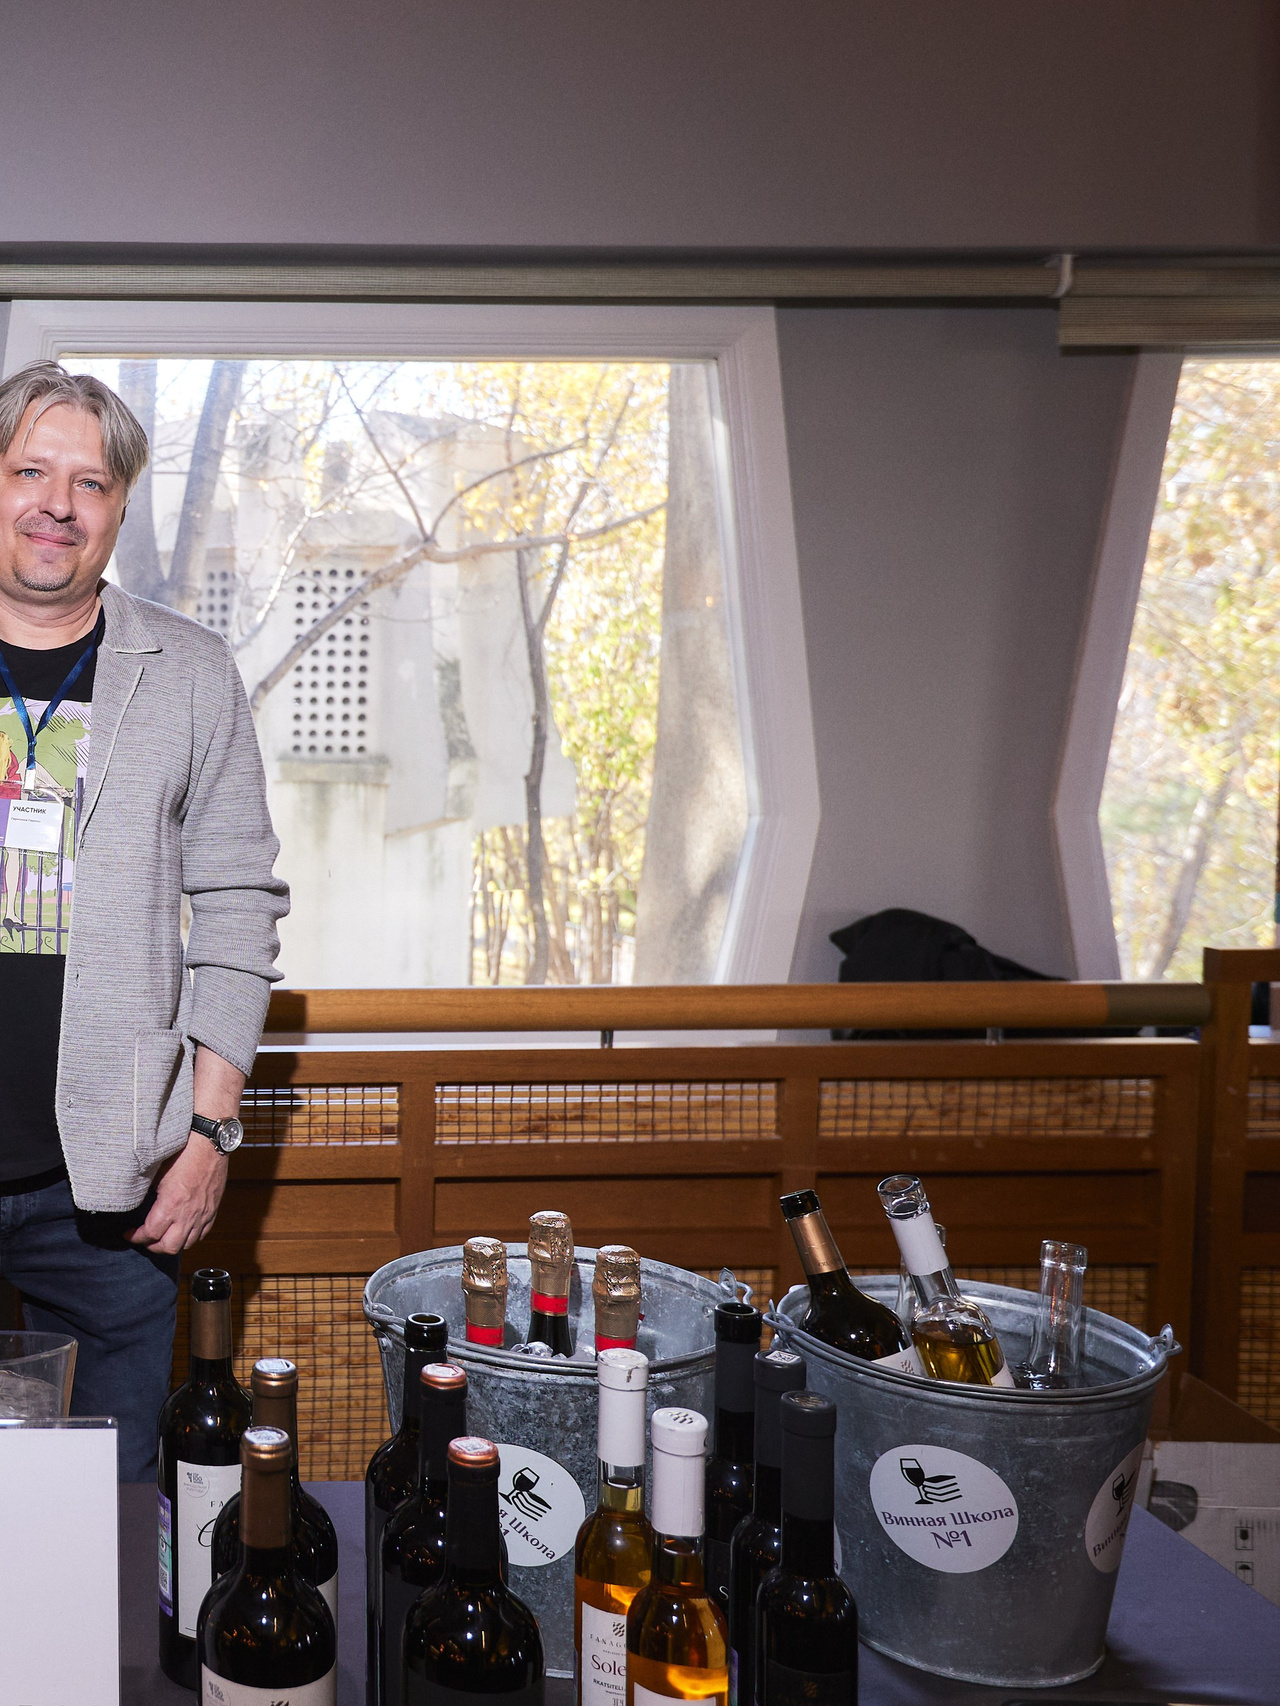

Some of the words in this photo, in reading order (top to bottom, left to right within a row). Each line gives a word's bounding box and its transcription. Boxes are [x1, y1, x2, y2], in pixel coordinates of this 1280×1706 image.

[13, 806, 46, 814] УЧАСТНИК
[881, 1511, 947, 1527] Винная
[950, 1507, 1016, 1525] Школа
[508, 1517, 557, 1560] Школа
[931, 1530, 972, 1549] №1
